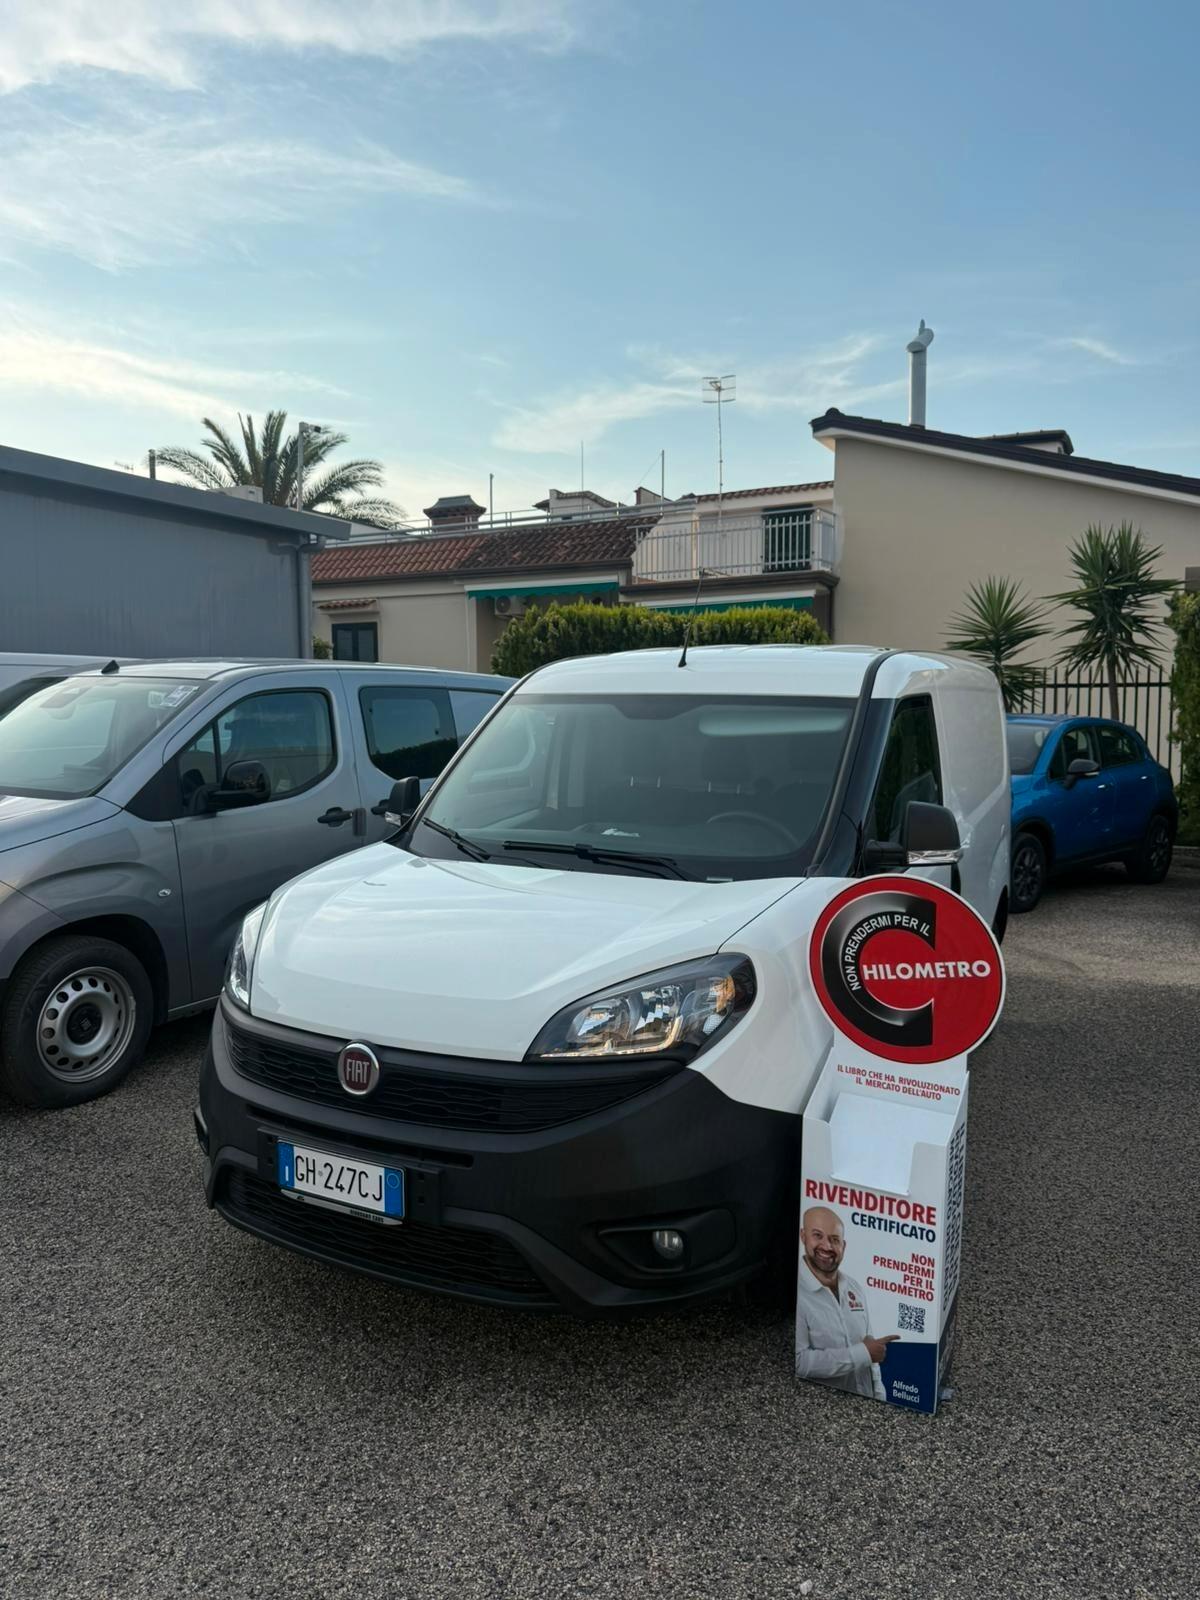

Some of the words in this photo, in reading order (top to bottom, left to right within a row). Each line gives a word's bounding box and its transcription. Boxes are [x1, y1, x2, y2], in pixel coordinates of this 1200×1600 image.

[893, 915, 919, 930] PER
[919, 923, 931, 937] IL
[845, 915, 892, 964] PRENDERMI
[845, 965, 861, 991] NON
[862, 960, 992, 981] HILOMETRO
[346, 1058, 370, 1084] FIAT
[837, 1064, 844, 1073] IL
[845, 1065, 867, 1077] LIBRO
[868, 1070, 883, 1080] CHE
[884, 1073, 896, 1083] HA
[898, 1076, 961, 1096] RIVOLUZIONATO
[856, 1076, 863, 1085] IL
[865, 1078, 901, 1093] MERCATO
[902, 1084, 942, 1101] DELL'AUTO
[805, 1178, 937, 1226] RIVENDITORE
[851, 1211, 936, 1243] CERTIFICATO
[873, 1255, 935, 1279] PRENDERMI
[911, 1253, 935, 1268] NON
[866, 1276, 934, 1302] CHILOMETRO
[903, 1274, 923, 1288] PER
[925, 1278, 935, 1291] IL
[893, 1380, 919, 1394] Alfredo
[893, 1389, 920, 1403] Bellucci
